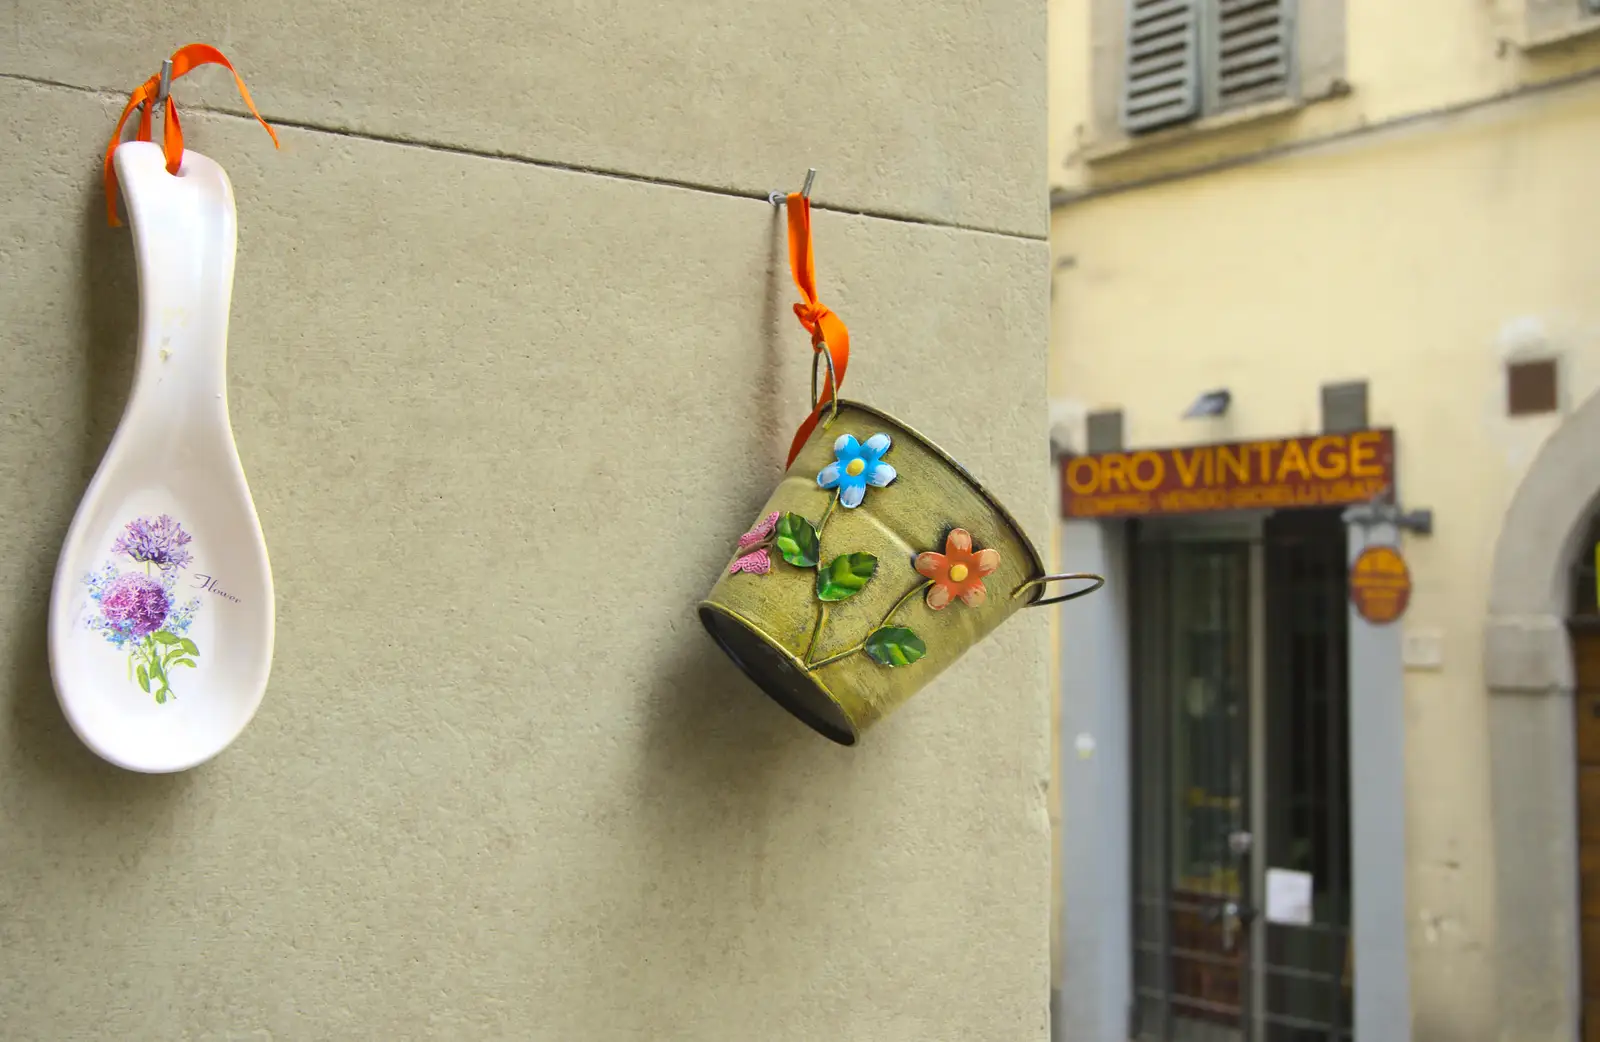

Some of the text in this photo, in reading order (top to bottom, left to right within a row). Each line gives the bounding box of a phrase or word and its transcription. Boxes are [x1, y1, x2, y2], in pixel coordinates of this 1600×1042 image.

[1066, 432, 1384, 494] ORO VINTAGE
[190, 573, 242, 604] Flower
